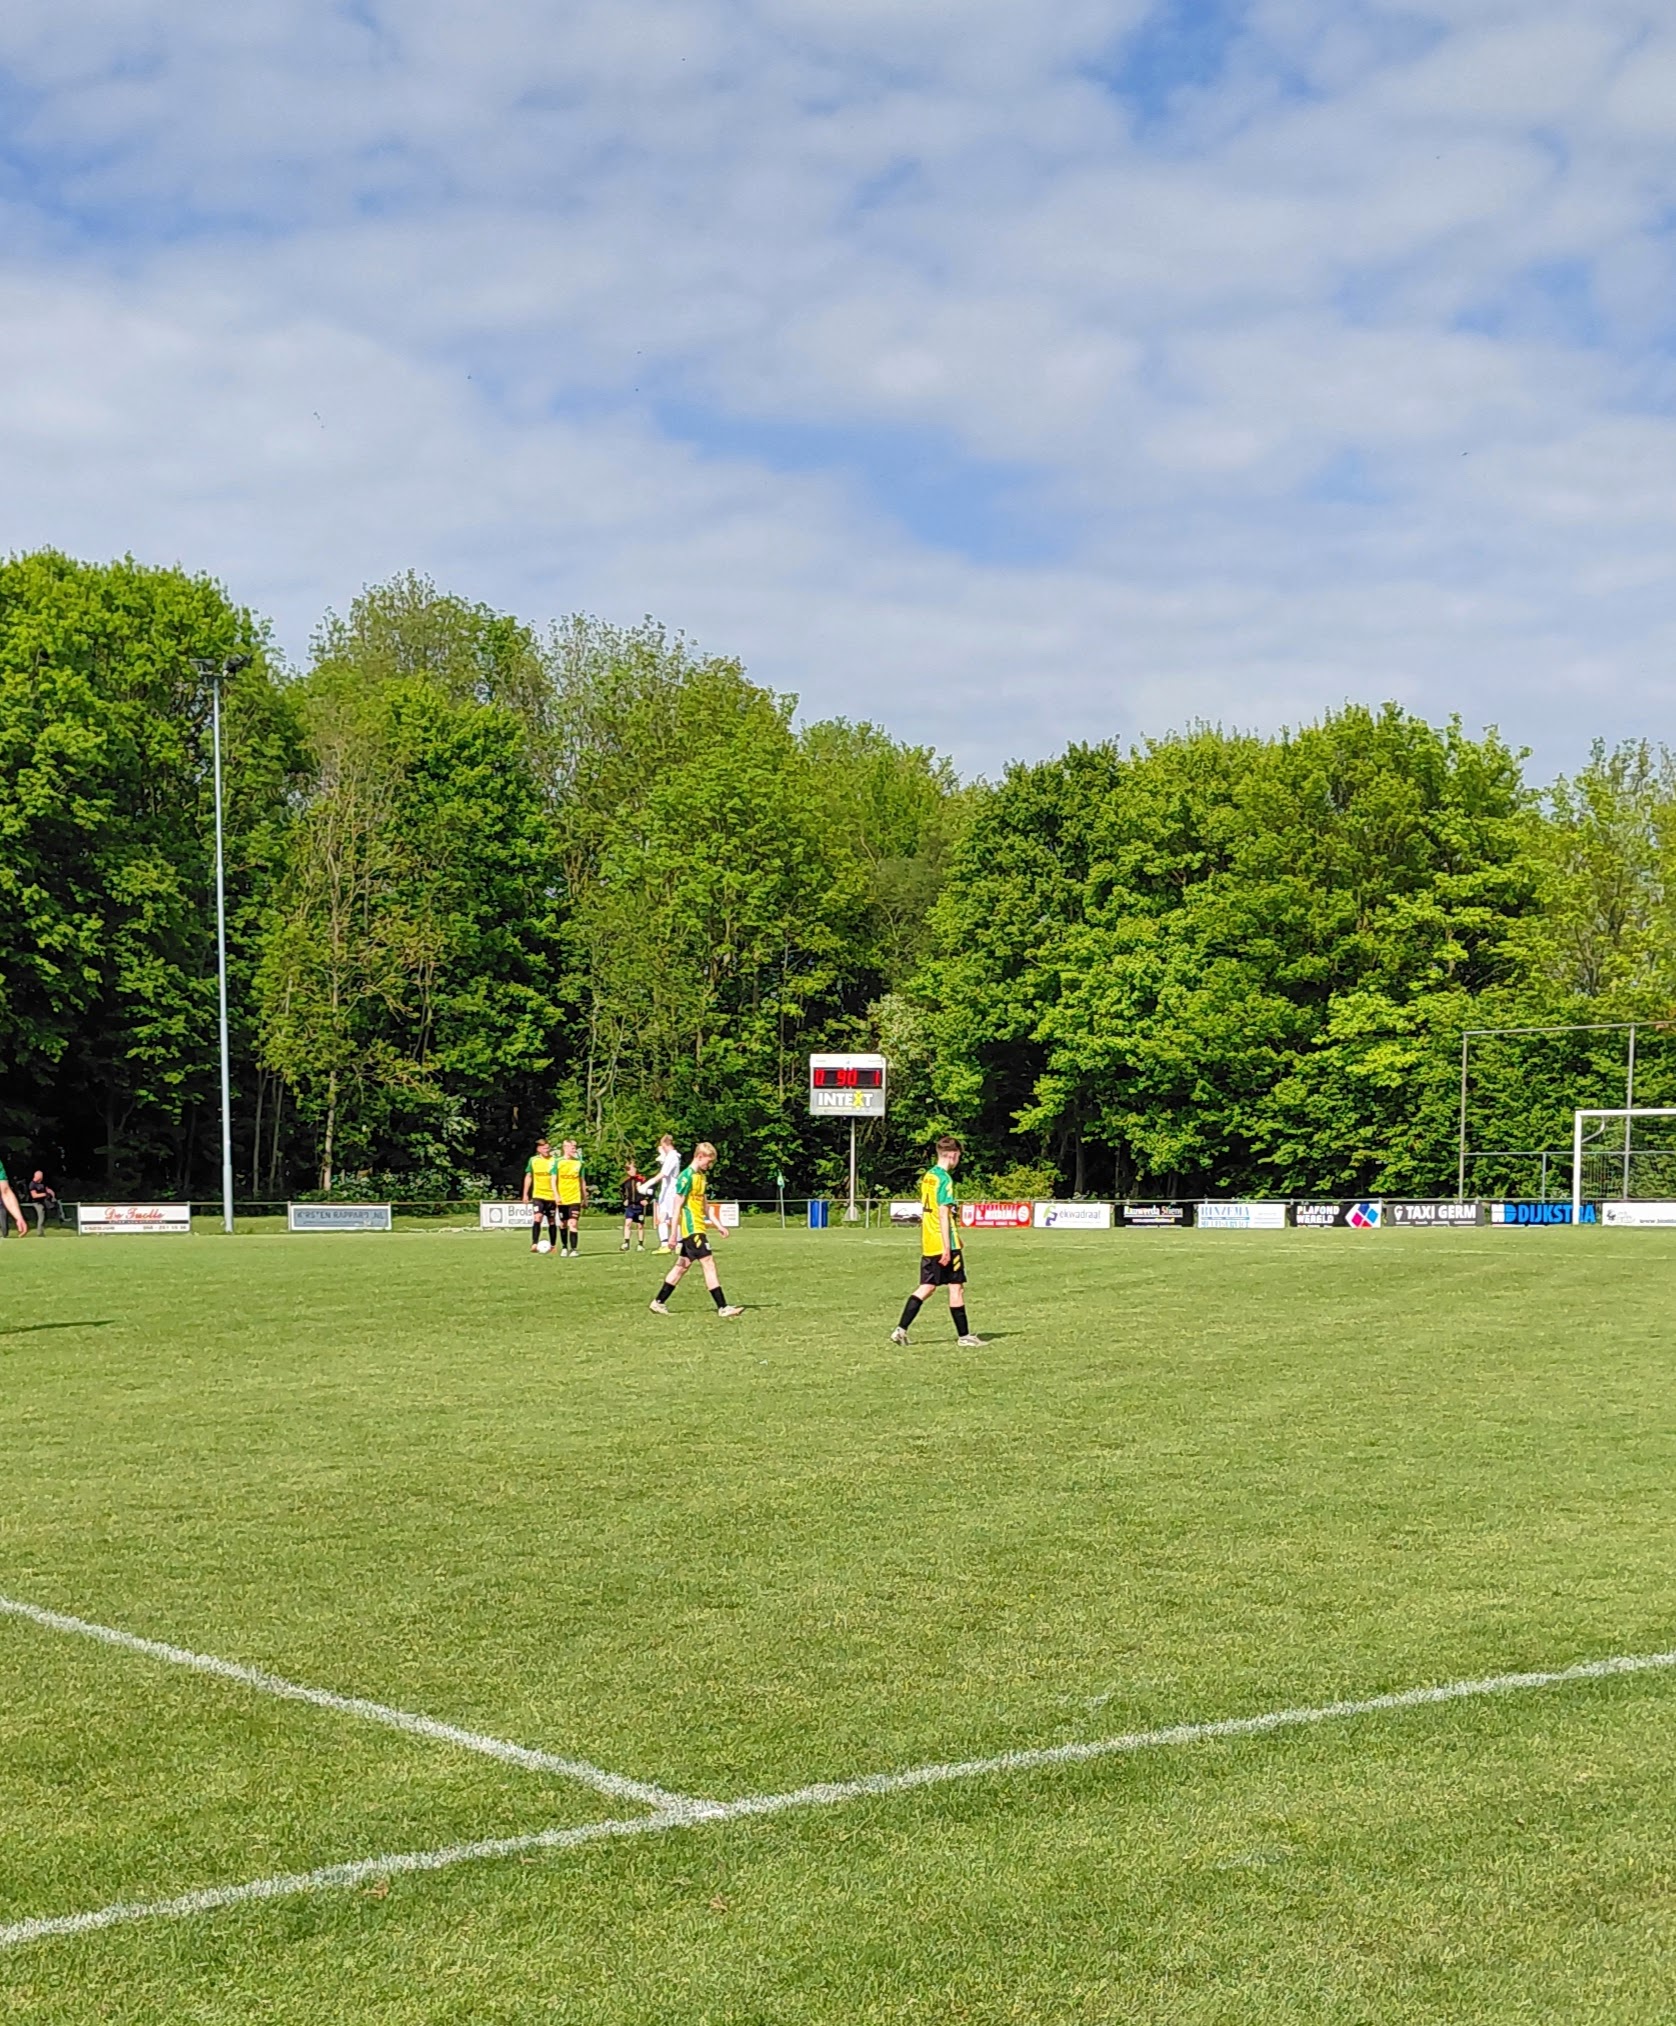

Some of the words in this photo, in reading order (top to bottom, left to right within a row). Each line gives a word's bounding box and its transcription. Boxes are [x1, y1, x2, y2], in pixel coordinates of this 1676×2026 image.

[836, 1069, 858, 1087] 90
[817, 1090, 874, 1109] INTEXT
[1296, 1205, 1340, 1215] PLAFOND
[1406, 1205, 1436, 1219] TAXI
[1438, 1205, 1476, 1219] GERM
[1296, 1214, 1335, 1224] WERELD
